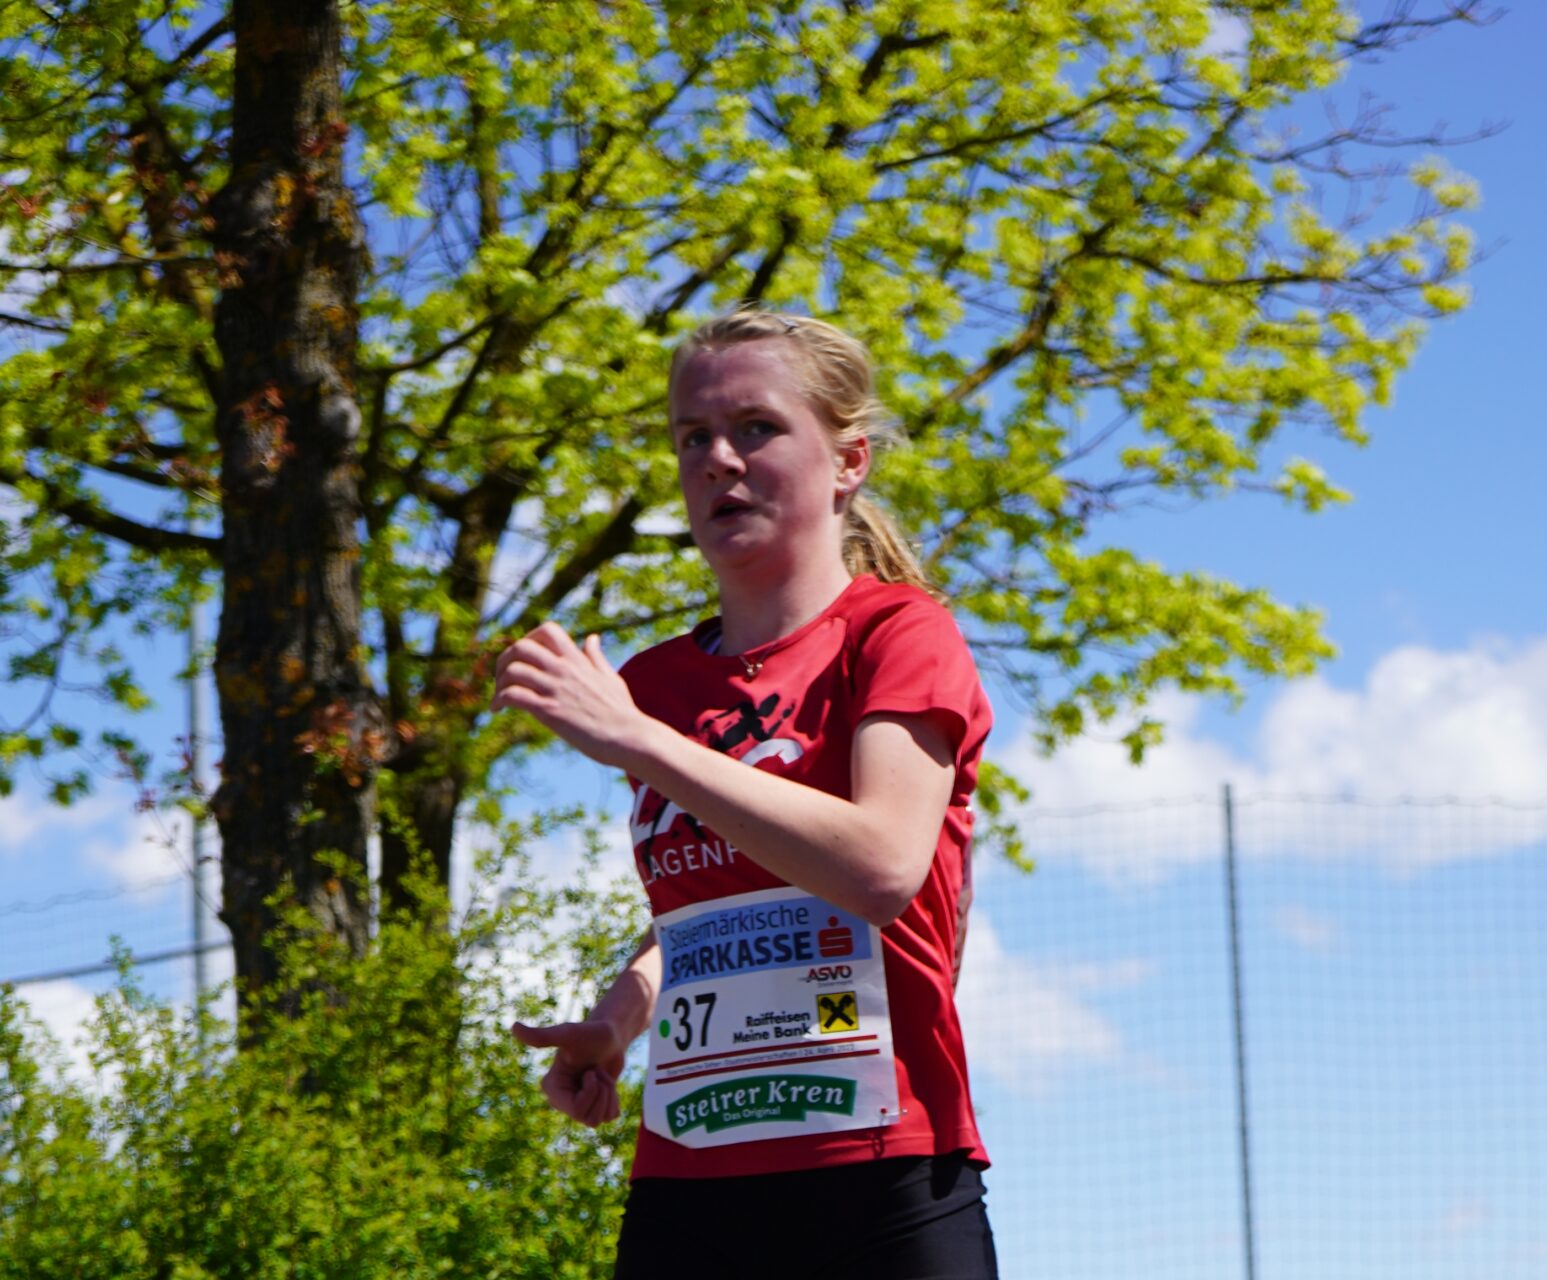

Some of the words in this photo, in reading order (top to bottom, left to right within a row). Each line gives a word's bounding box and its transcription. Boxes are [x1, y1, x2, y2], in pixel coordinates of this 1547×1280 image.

[668, 904, 809, 951] Steiermärkische
[669, 931, 814, 984] SPARKASSE
[673, 992, 717, 1051] 37
[733, 1030, 770, 1043] Meine
[774, 1023, 812, 1038] Bank
[745, 1010, 811, 1027] Raiffeisen
[675, 1086, 761, 1128] Steirer
[767, 1080, 844, 1105] Kren
[722, 1112, 742, 1122] Das
[742, 1106, 781, 1119] Original
